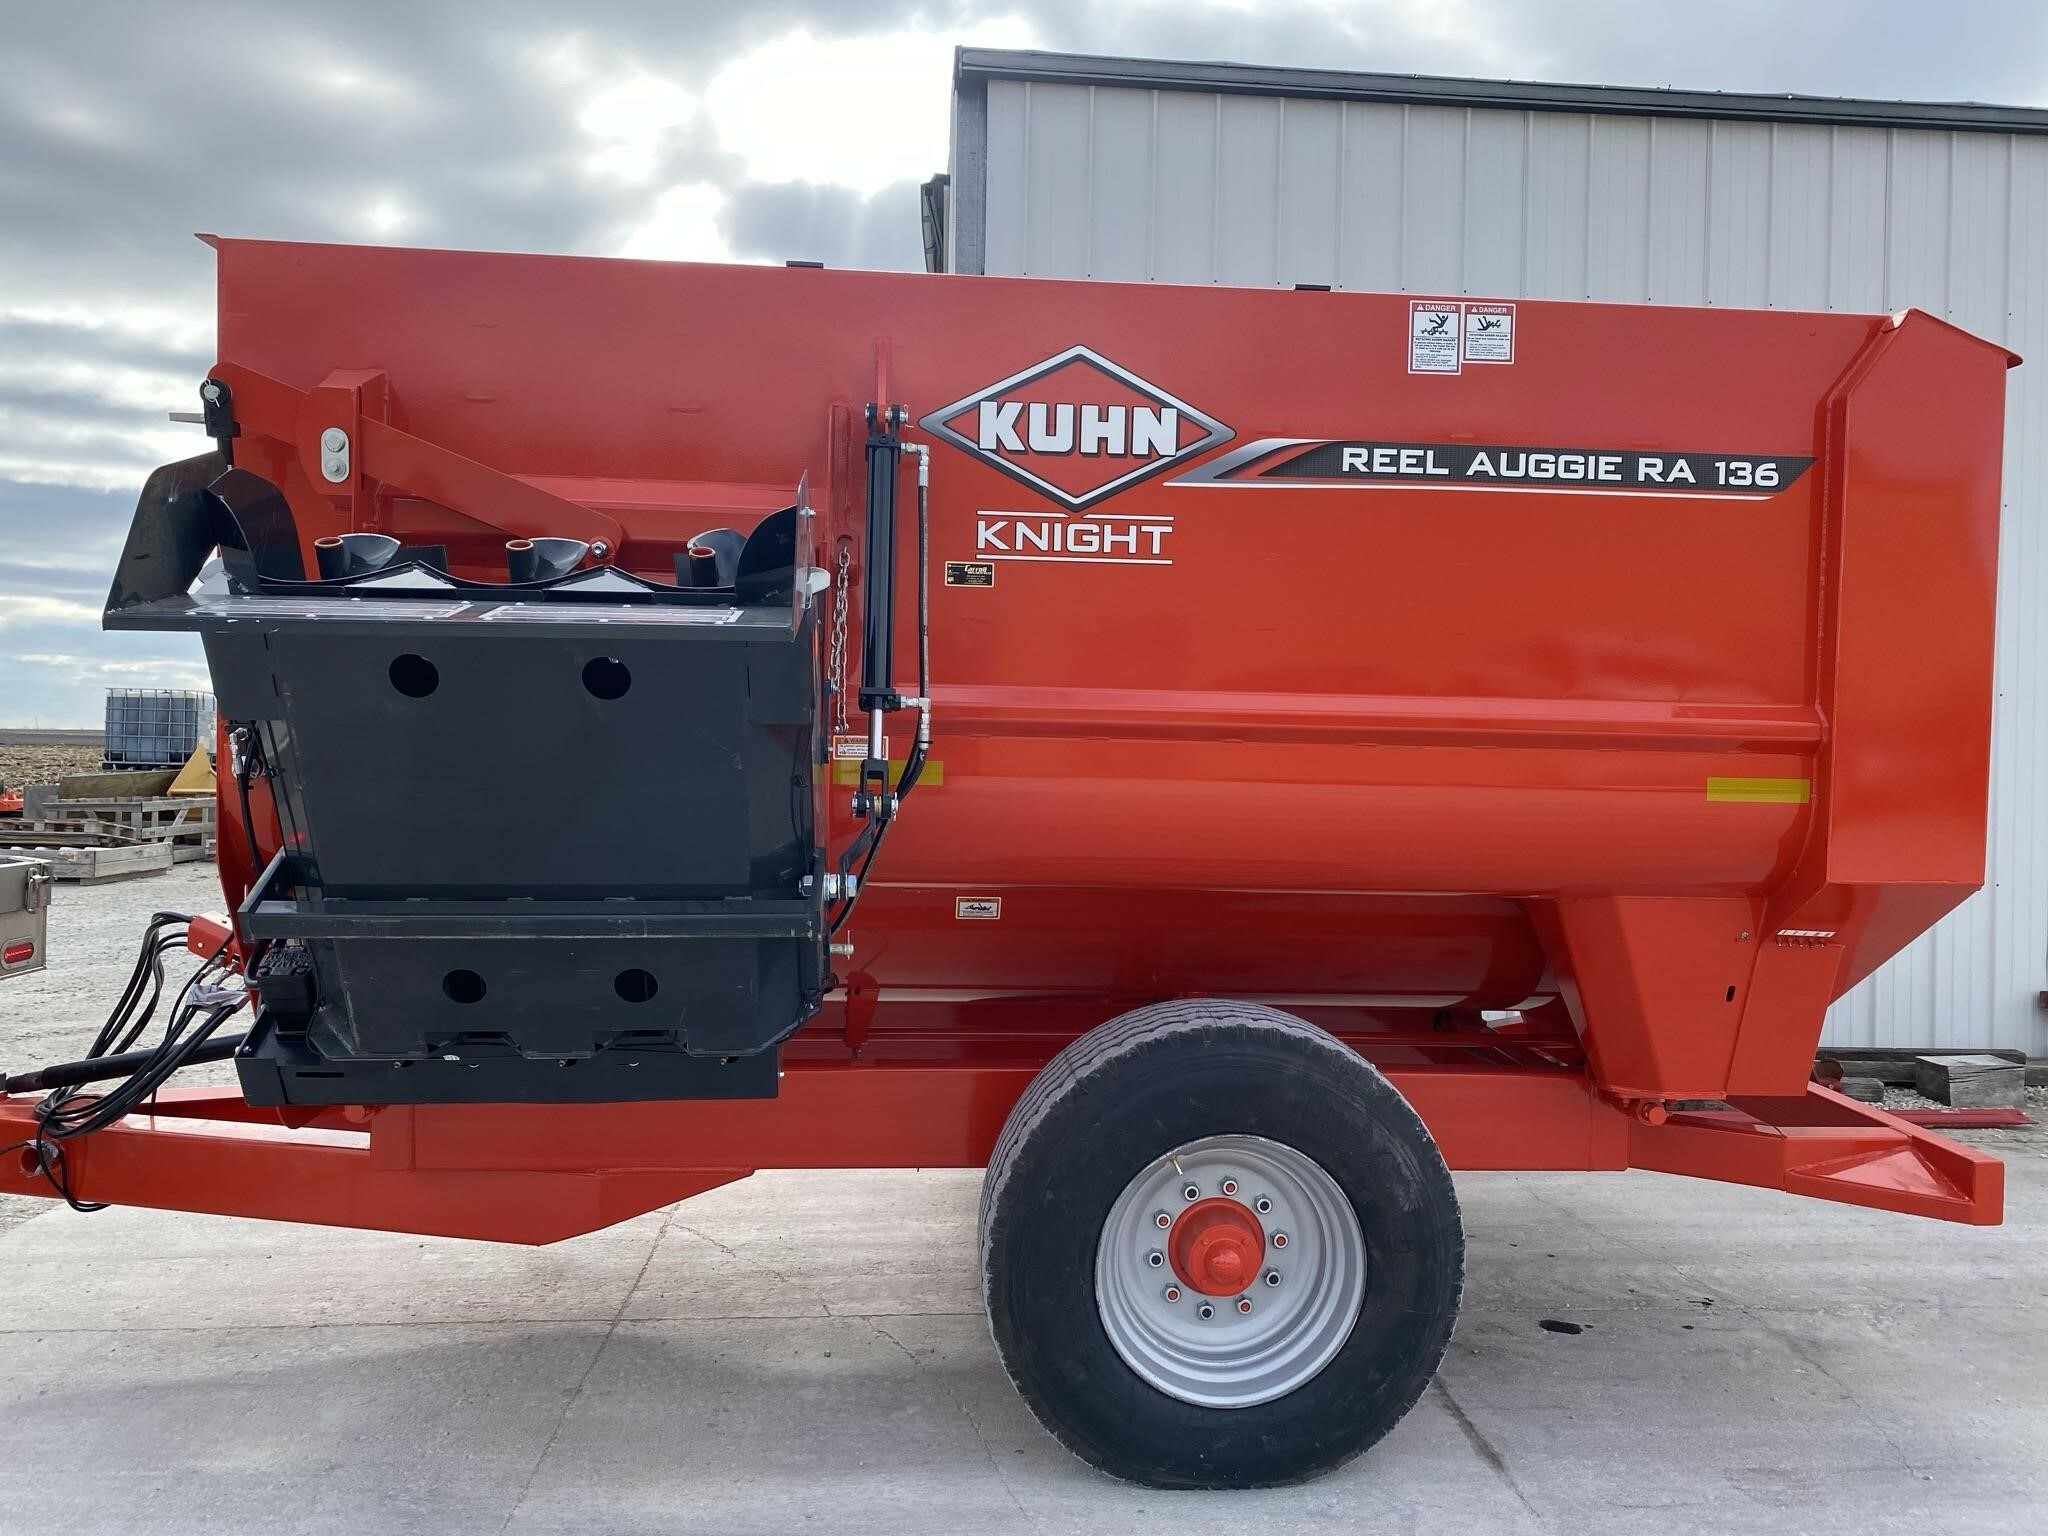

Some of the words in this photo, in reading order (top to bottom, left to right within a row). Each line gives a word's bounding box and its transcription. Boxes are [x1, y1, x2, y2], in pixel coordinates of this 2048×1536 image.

[1425, 304, 1456, 312] DANGER
[978, 401, 1178, 456] KUHN
[1342, 447, 1450, 474] REEL
[1466, 451, 1623, 481] AUGGIE
[1637, 457, 1697, 484] RA
[1714, 461, 1779, 487] 136
[977, 520, 1173, 554] KNIGHT
